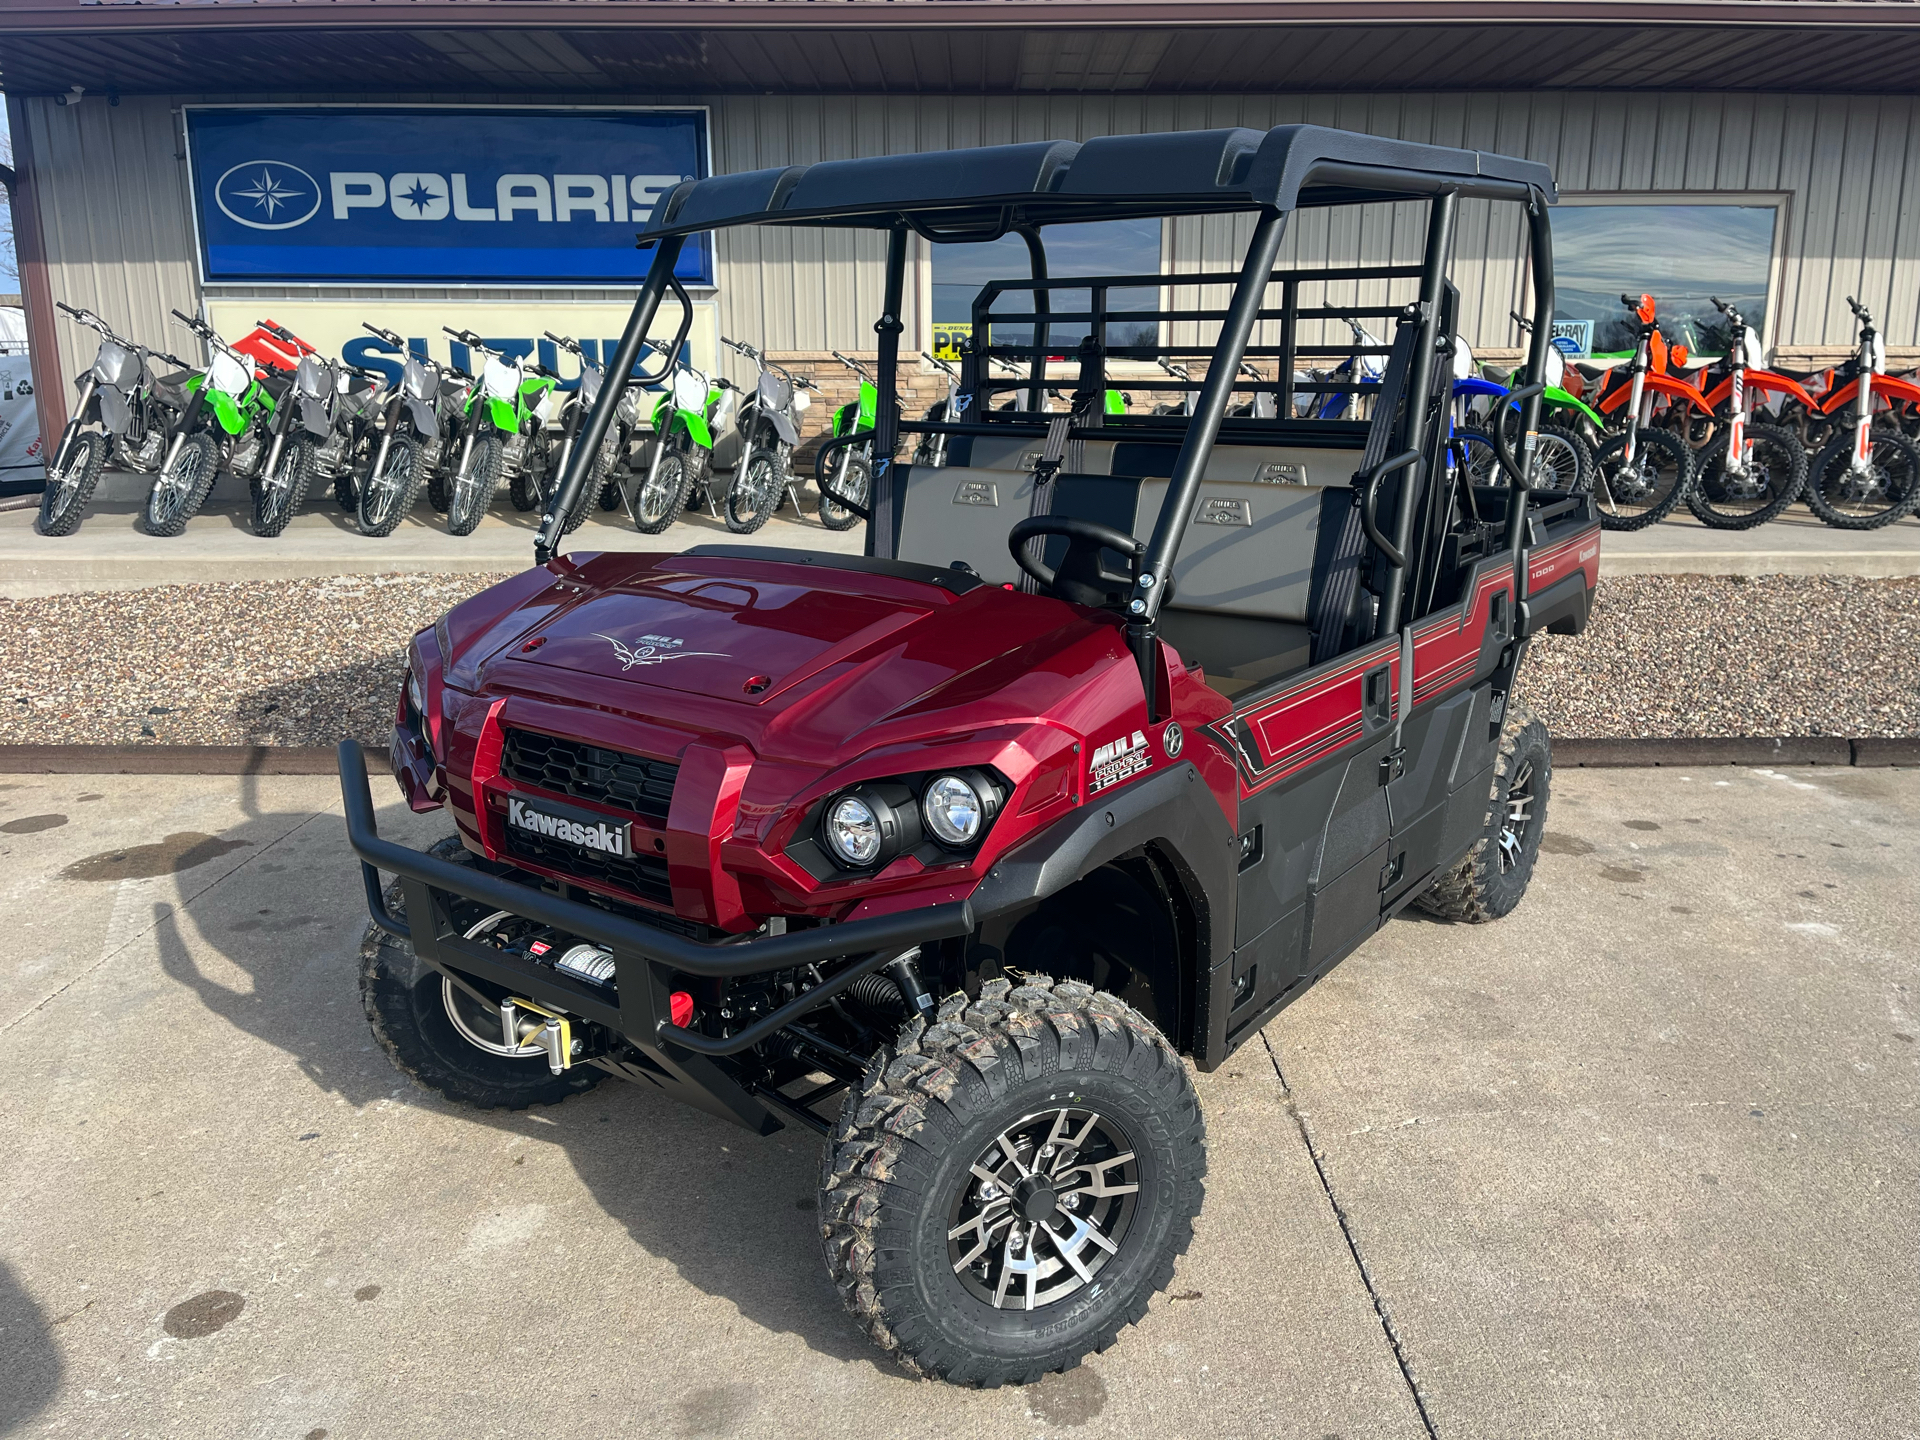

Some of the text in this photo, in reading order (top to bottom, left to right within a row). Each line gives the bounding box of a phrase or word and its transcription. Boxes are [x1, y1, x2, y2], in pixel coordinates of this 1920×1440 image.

[329, 172, 681, 222] POLARIS
[1532, 565, 1555, 579] 1000
[1089, 730, 1150, 774] MULE
[509, 798, 623, 855] Kawasaki
